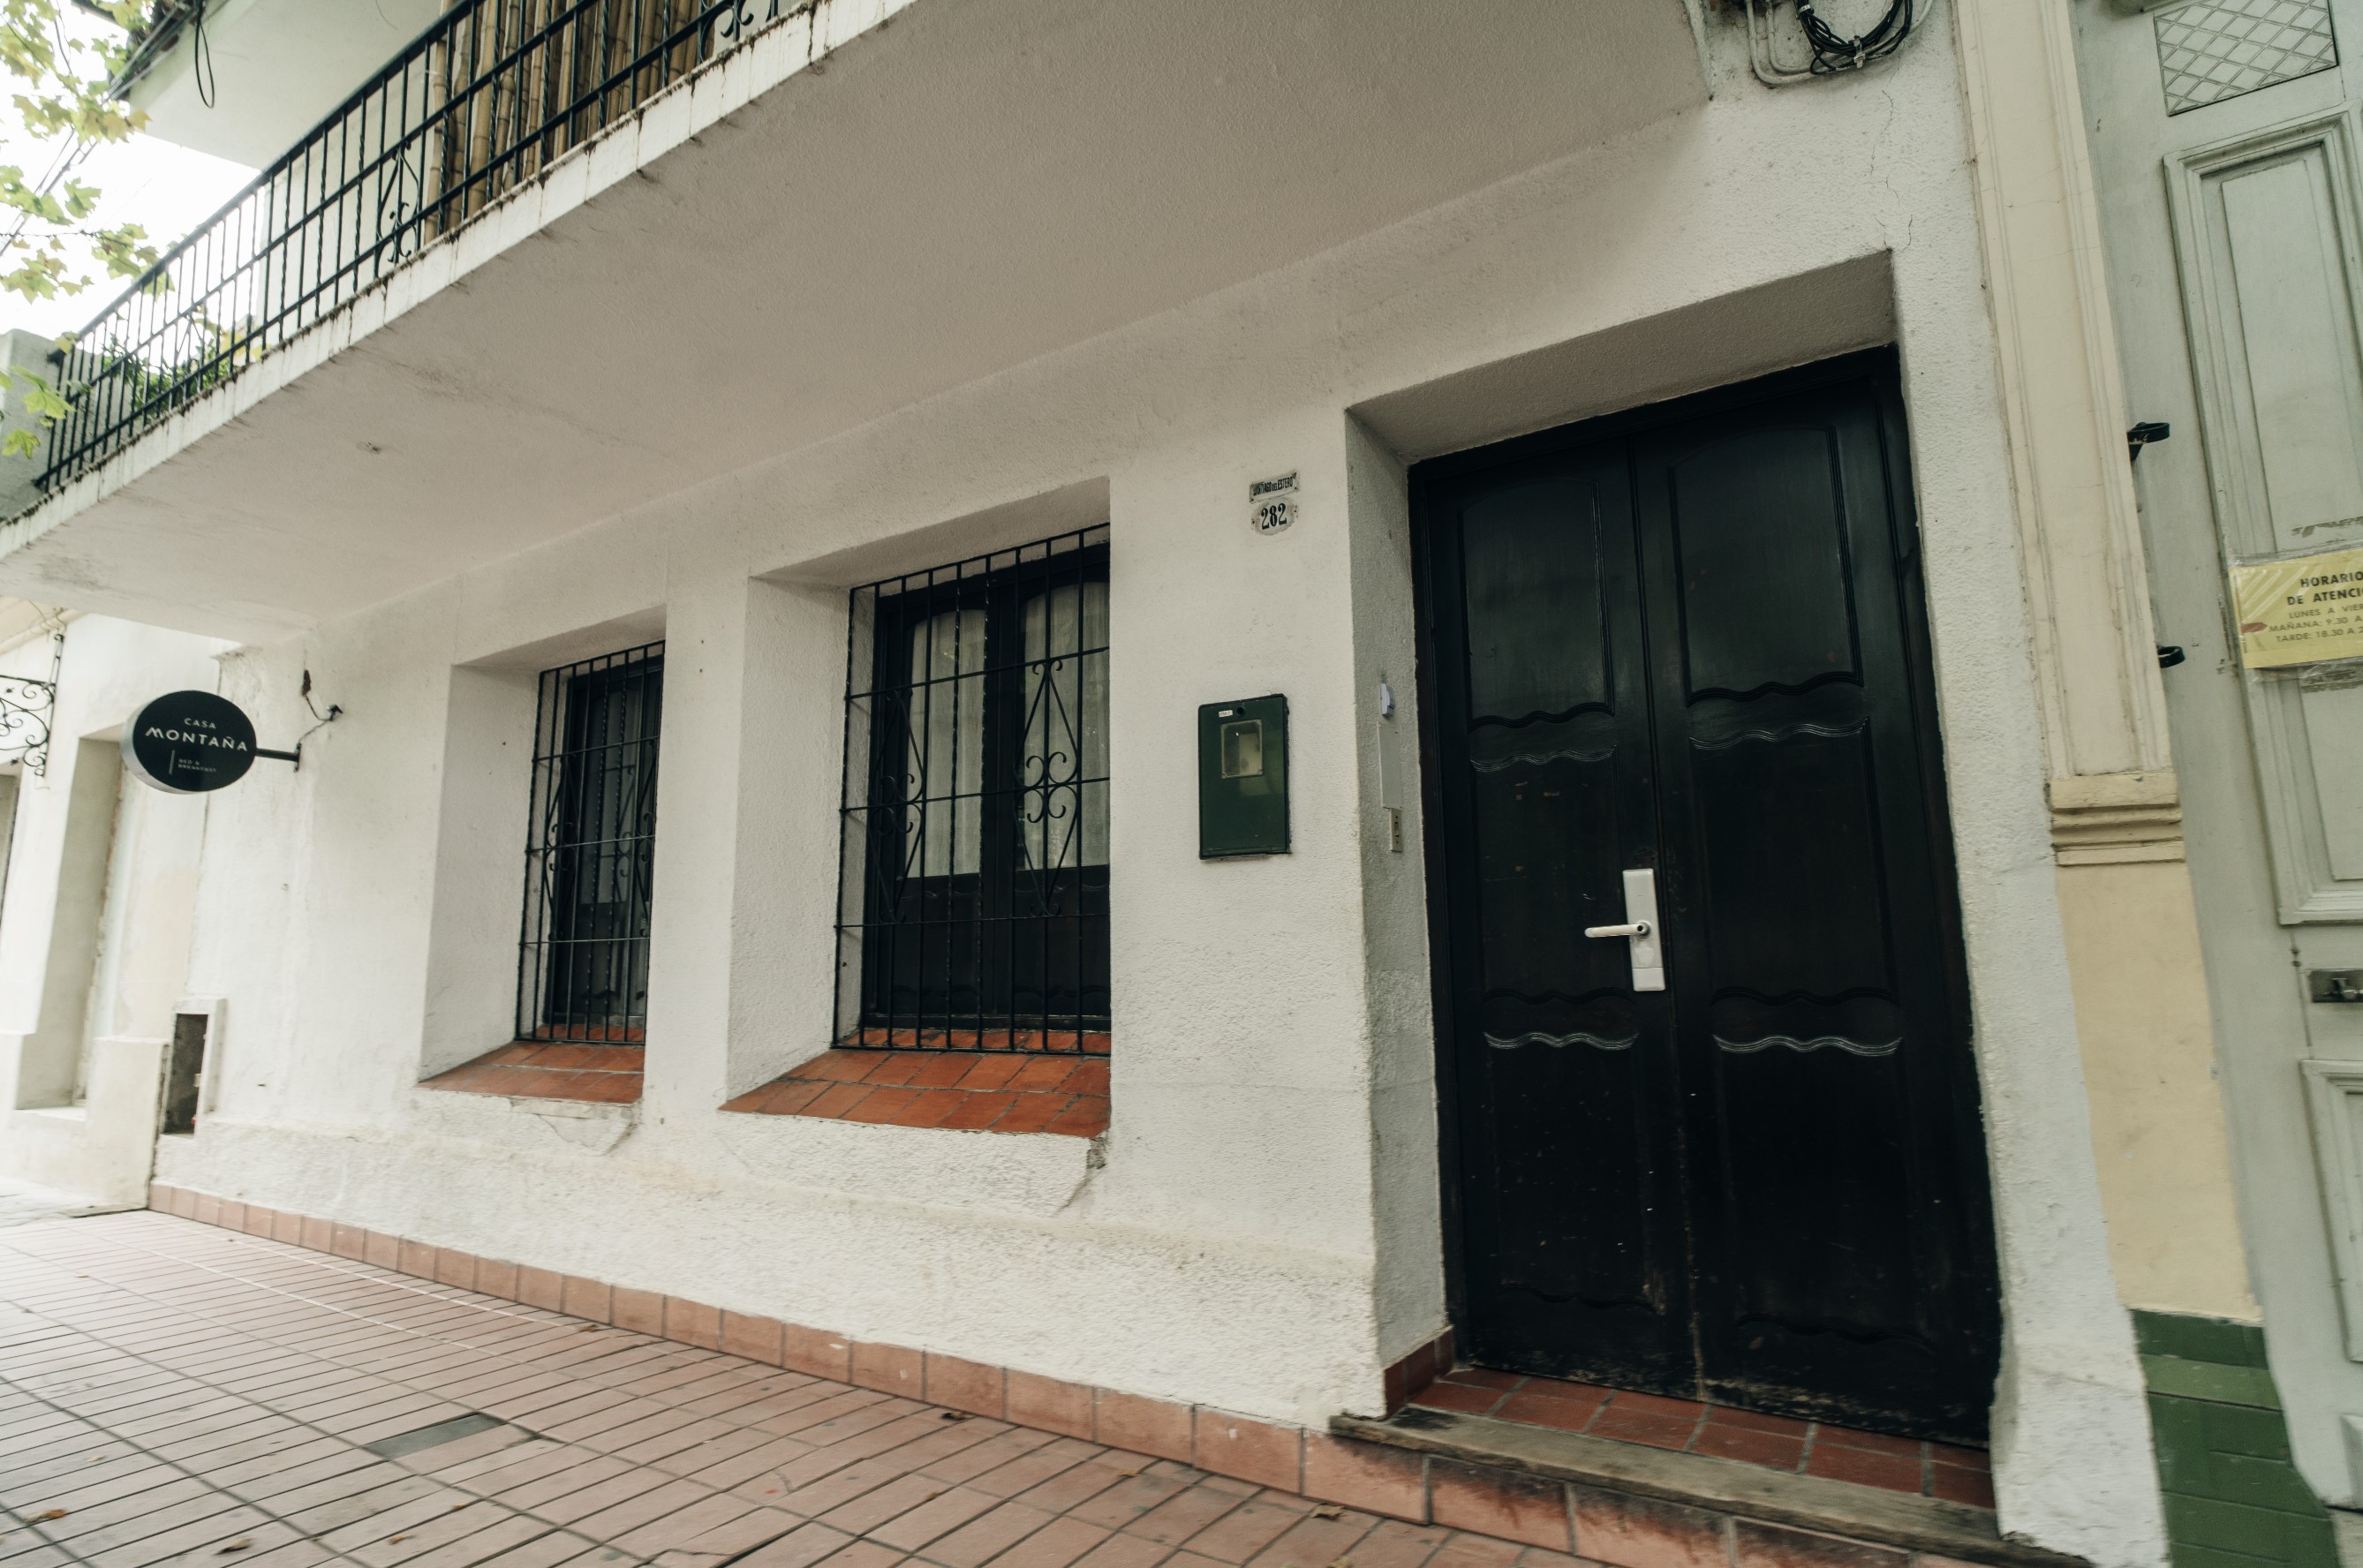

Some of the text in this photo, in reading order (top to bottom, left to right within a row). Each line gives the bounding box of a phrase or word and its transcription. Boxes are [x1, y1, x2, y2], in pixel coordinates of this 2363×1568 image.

[1260, 502, 1287, 530] 282
[2300, 570, 2363, 588] HORARIO
[2287, 587, 2363, 606] DE ATENCI
[2289, 608, 2321, 619] LUNES
[184, 717, 216, 729] CASA
[145, 727, 248, 751] MONTAÑA
